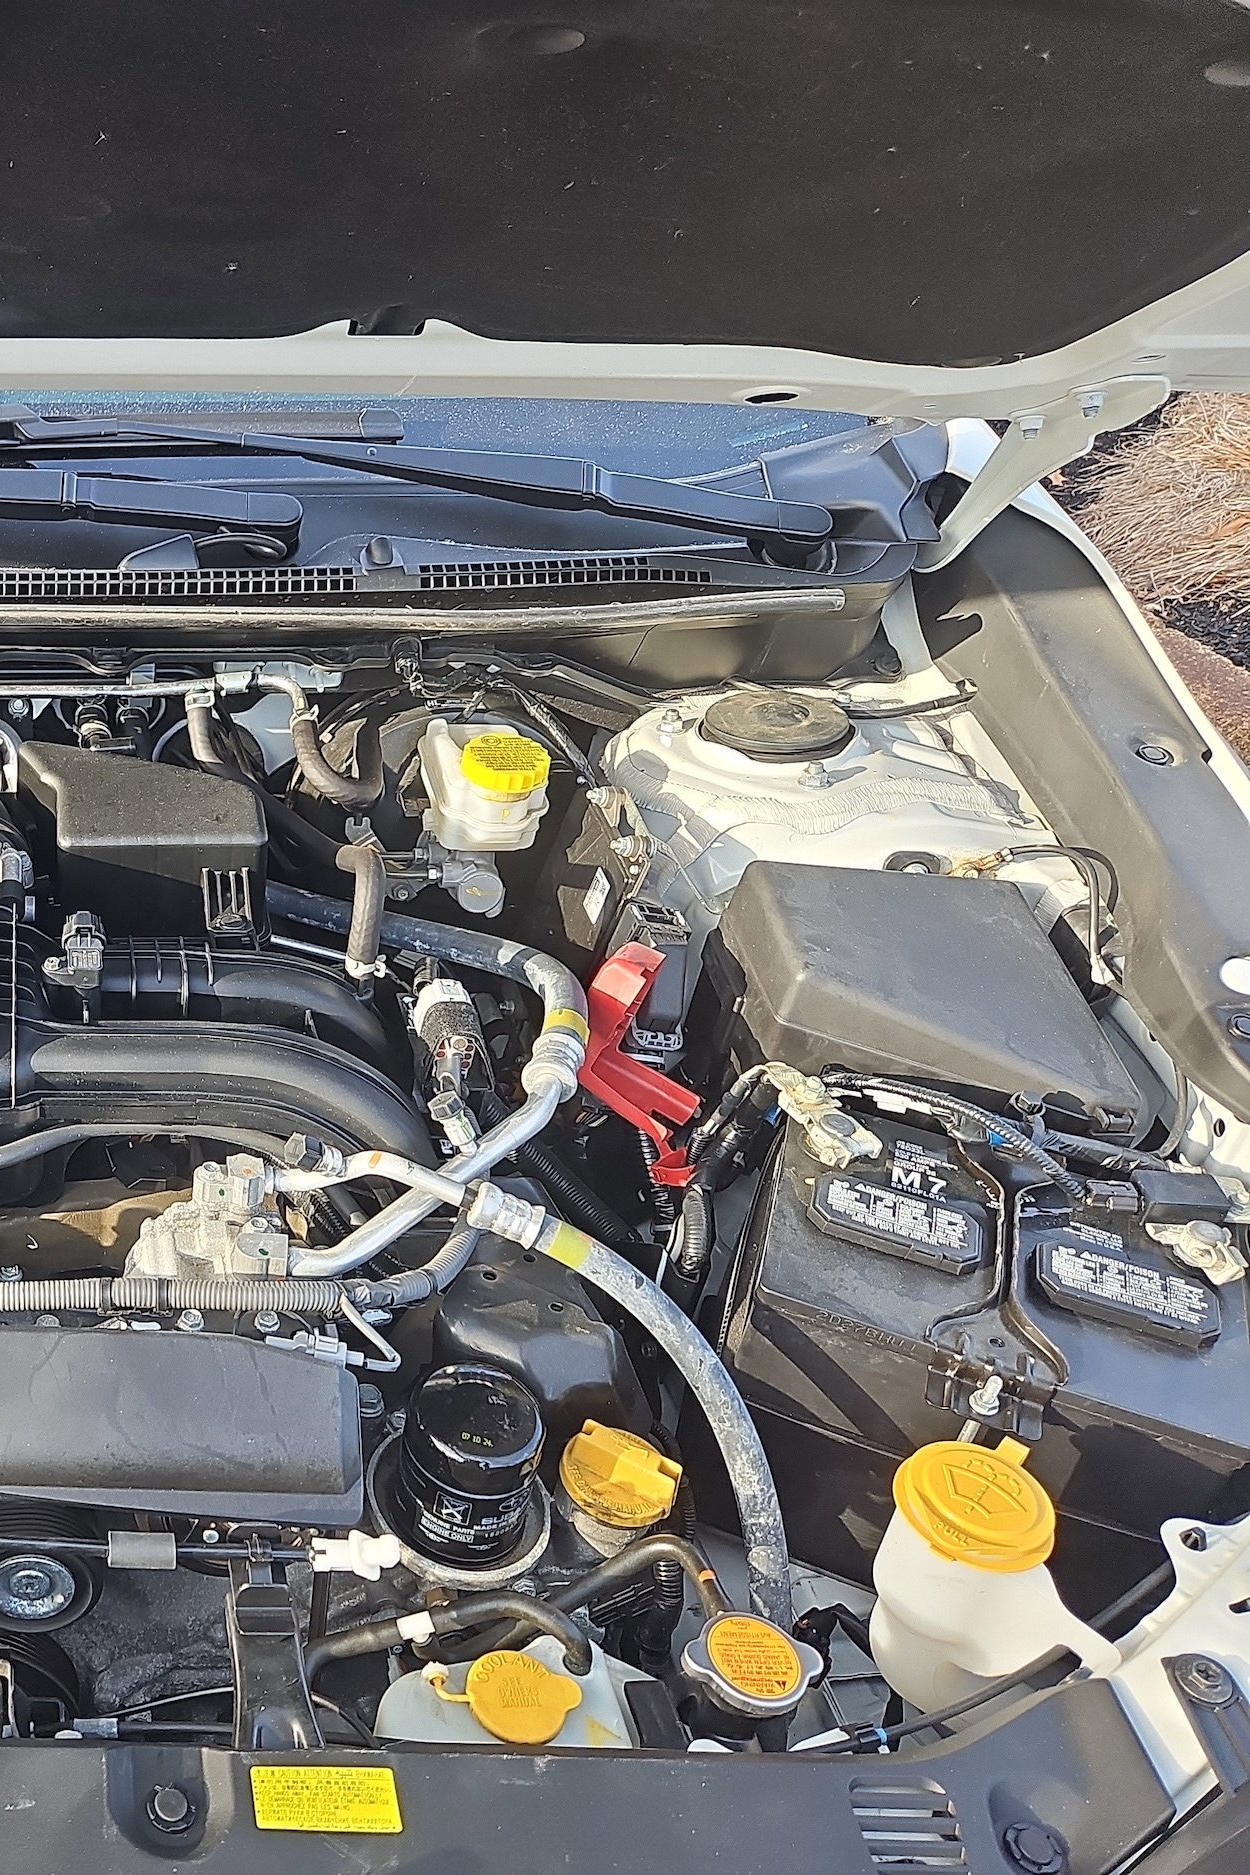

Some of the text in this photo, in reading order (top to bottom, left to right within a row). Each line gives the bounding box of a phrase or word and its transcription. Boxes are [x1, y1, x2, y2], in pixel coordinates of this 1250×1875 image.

[894, 1161, 924, 1173] GROUP
[453, 1525, 475, 1535] PARTS
[473, 1523, 498, 1531] MADE
[933, 1520, 971, 1547] PULL
[473, 1653, 551, 1683] COOLANT
[501, 1677, 520, 1687] SEE
[501, 1697, 542, 1708] MANUAL
[278, 1769, 301, 1777] CAUTION
